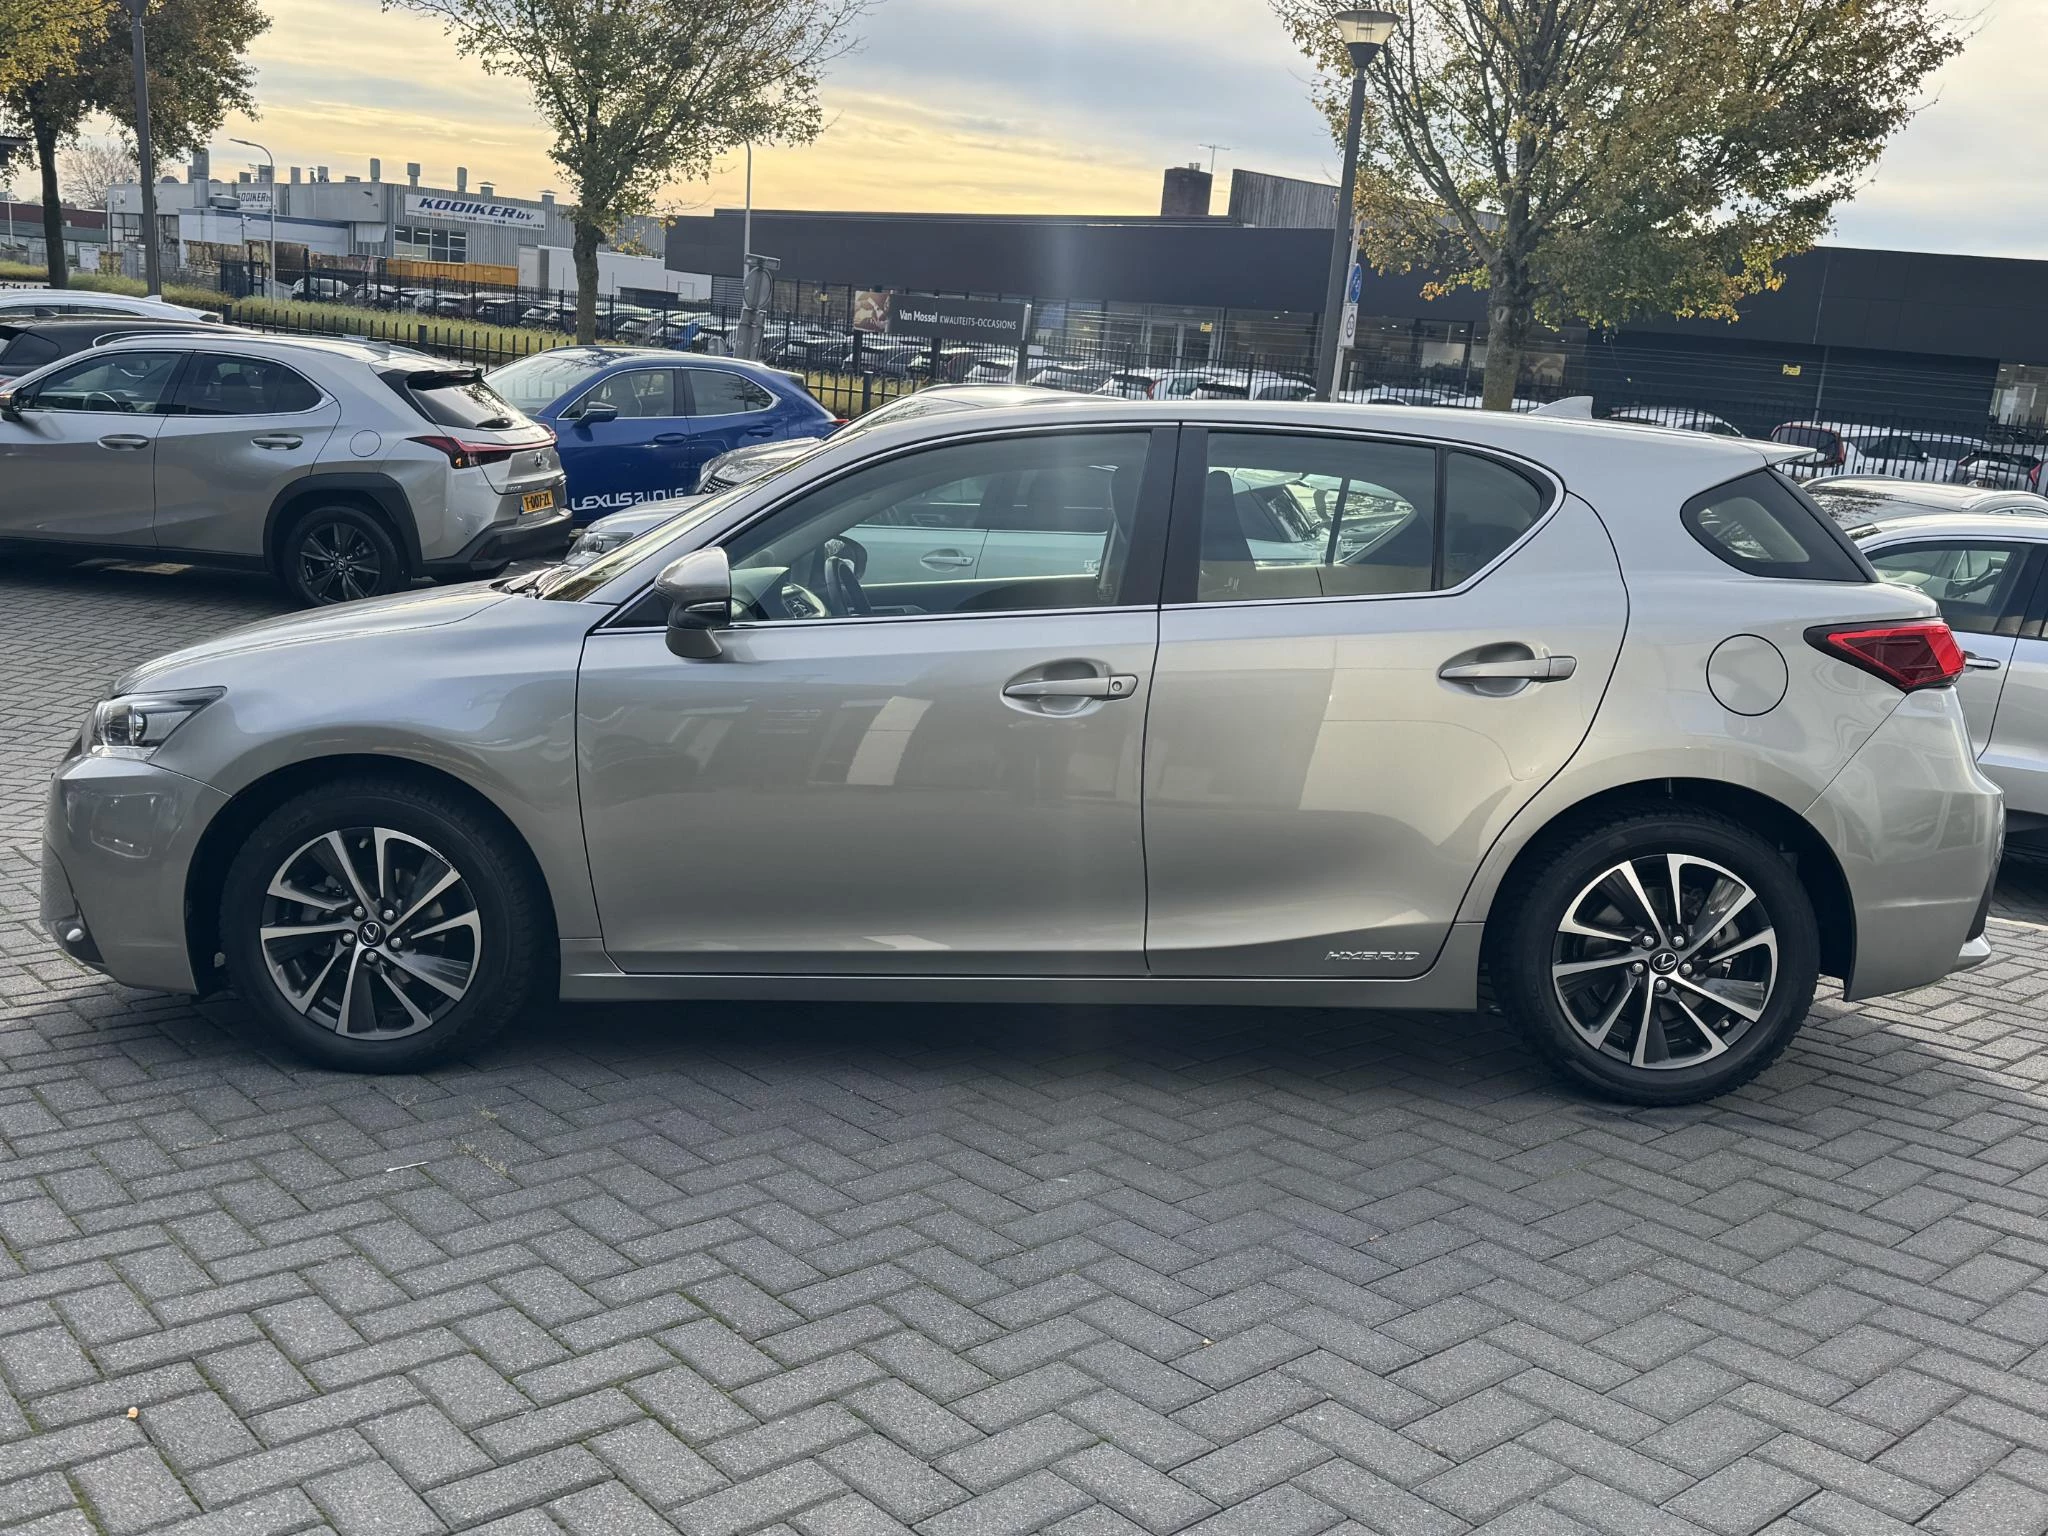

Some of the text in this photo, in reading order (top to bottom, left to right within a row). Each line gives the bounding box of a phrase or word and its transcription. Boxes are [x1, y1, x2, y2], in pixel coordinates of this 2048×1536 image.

[418, 197, 517, 219] KOOIKER
[515, 209, 535, 221] bv
[900, 309, 1017, 330] Van Mossel KWALITEITS-OCCASIONS
[571, 492, 634, 511] LEXUS
[1324, 950, 1421, 961] HYBRID
